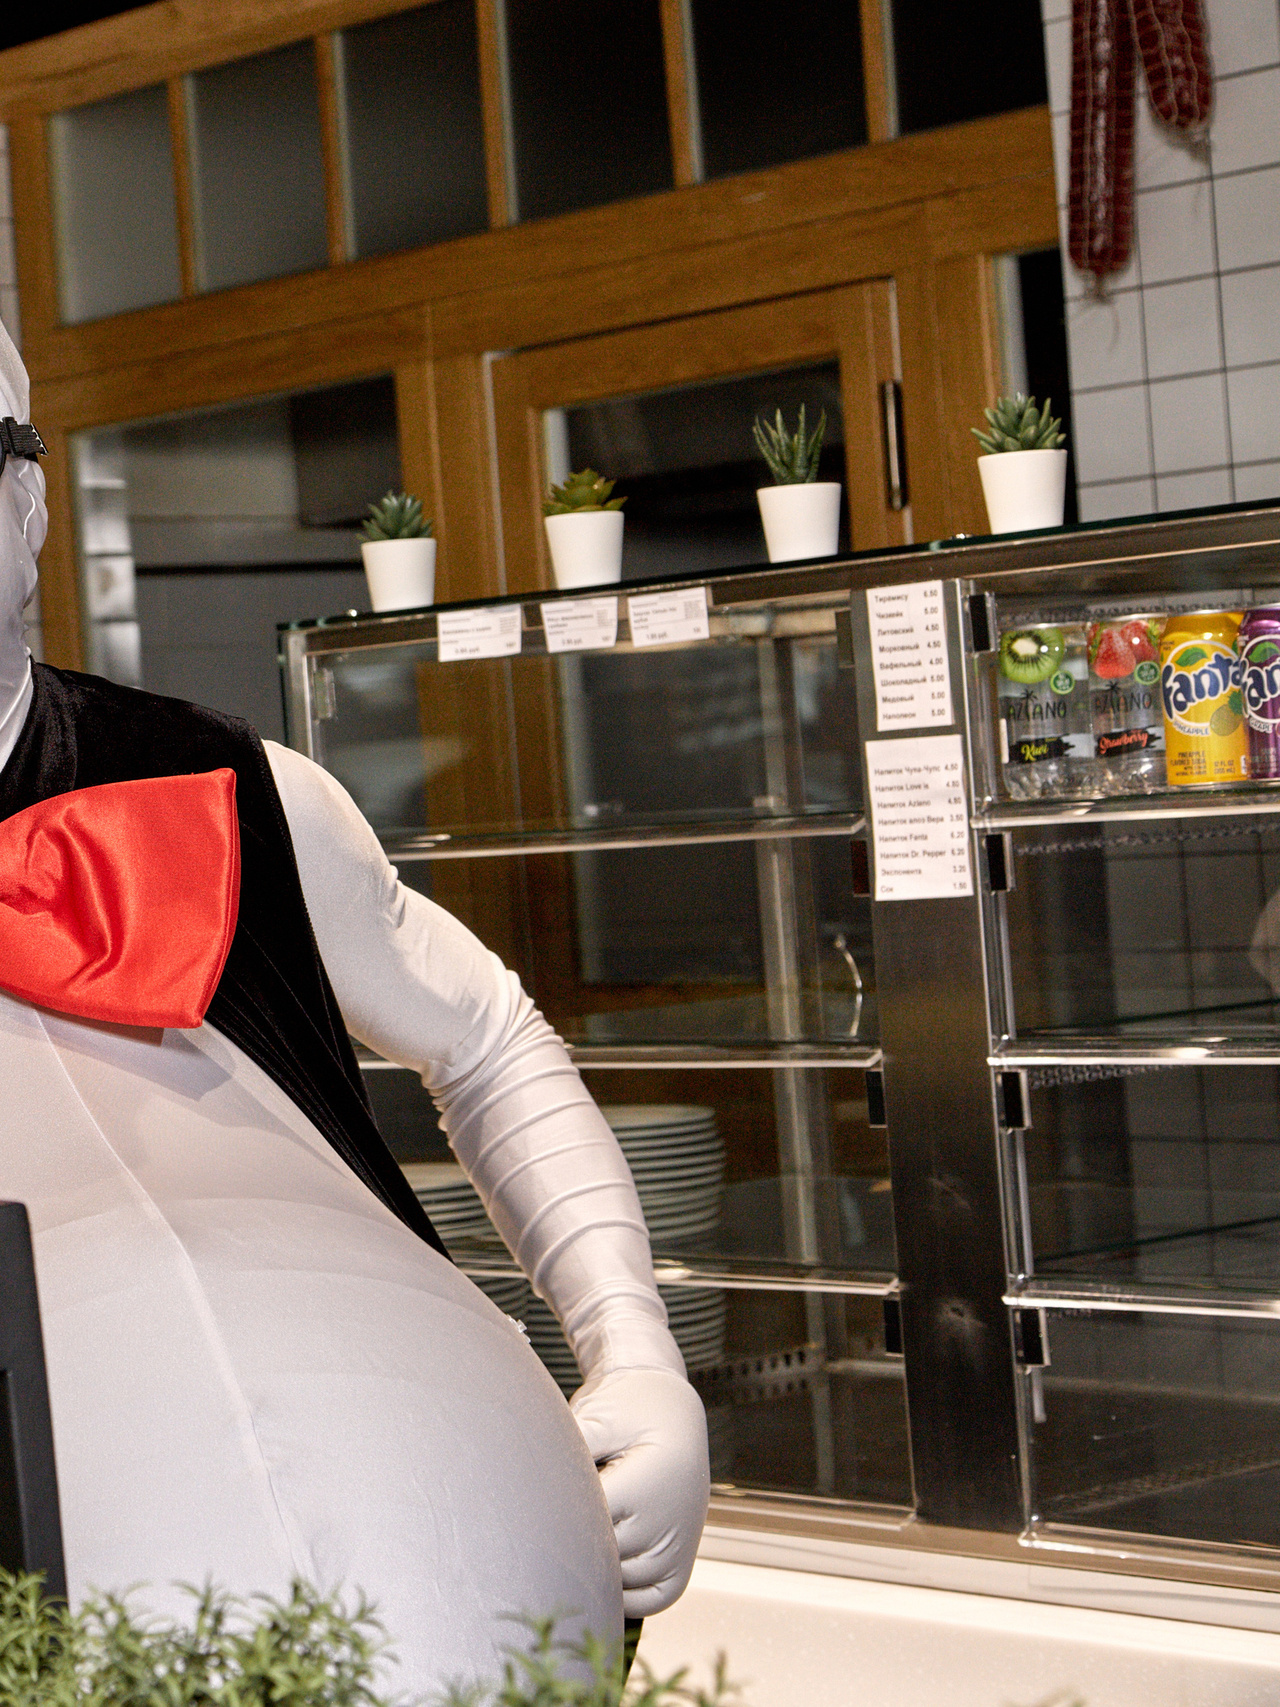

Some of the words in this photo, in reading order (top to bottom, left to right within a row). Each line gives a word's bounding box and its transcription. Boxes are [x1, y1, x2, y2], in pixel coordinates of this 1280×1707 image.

[875, 593, 909, 603] Тирамису
[924, 606, 939, 615] 5.00
[925, 623, 939, 632] 4.50
[878, 642, 920, 654] Морковный
[927, 640, 942, 649] 4.50
[880, 659, 923, 671] Вафельный
[929, 657, 943, 666] 4.00
[880, 675, 928, 687] Шоколадный
[930, 674, 945, 683] 5.00
[882, 694, 915, 704] Медовый
[931, 691, 946, 700] 5.00
[882, 712, 917, 721] Наполеон
[931, 708, 946, 717] 5.00
[1173, 720, 1212, 736] PINEAPPLE
[1099, 732, 1148, 754] Strawberry
[1021, 743, 1049, 762] Kiwi
[874, 767, 903, 776] Напиток
[875, 784, 904, 793] Напиток
[906, 783, 922, 791] Love
[877, 800, 906, 809] Напиток
[908, 799, 932, 808] Aziano
[878, 817, 907, 826] Напиток
[927, 815, 945, 825] Вера
[879, 834, 908, 843] Напиток
[909, 832, 929, 841] Fanta
[880, 851, 909, 860] Напиток
[922, 849, 947, 859] Pepper
[880, 885, 894, 894] Сок
